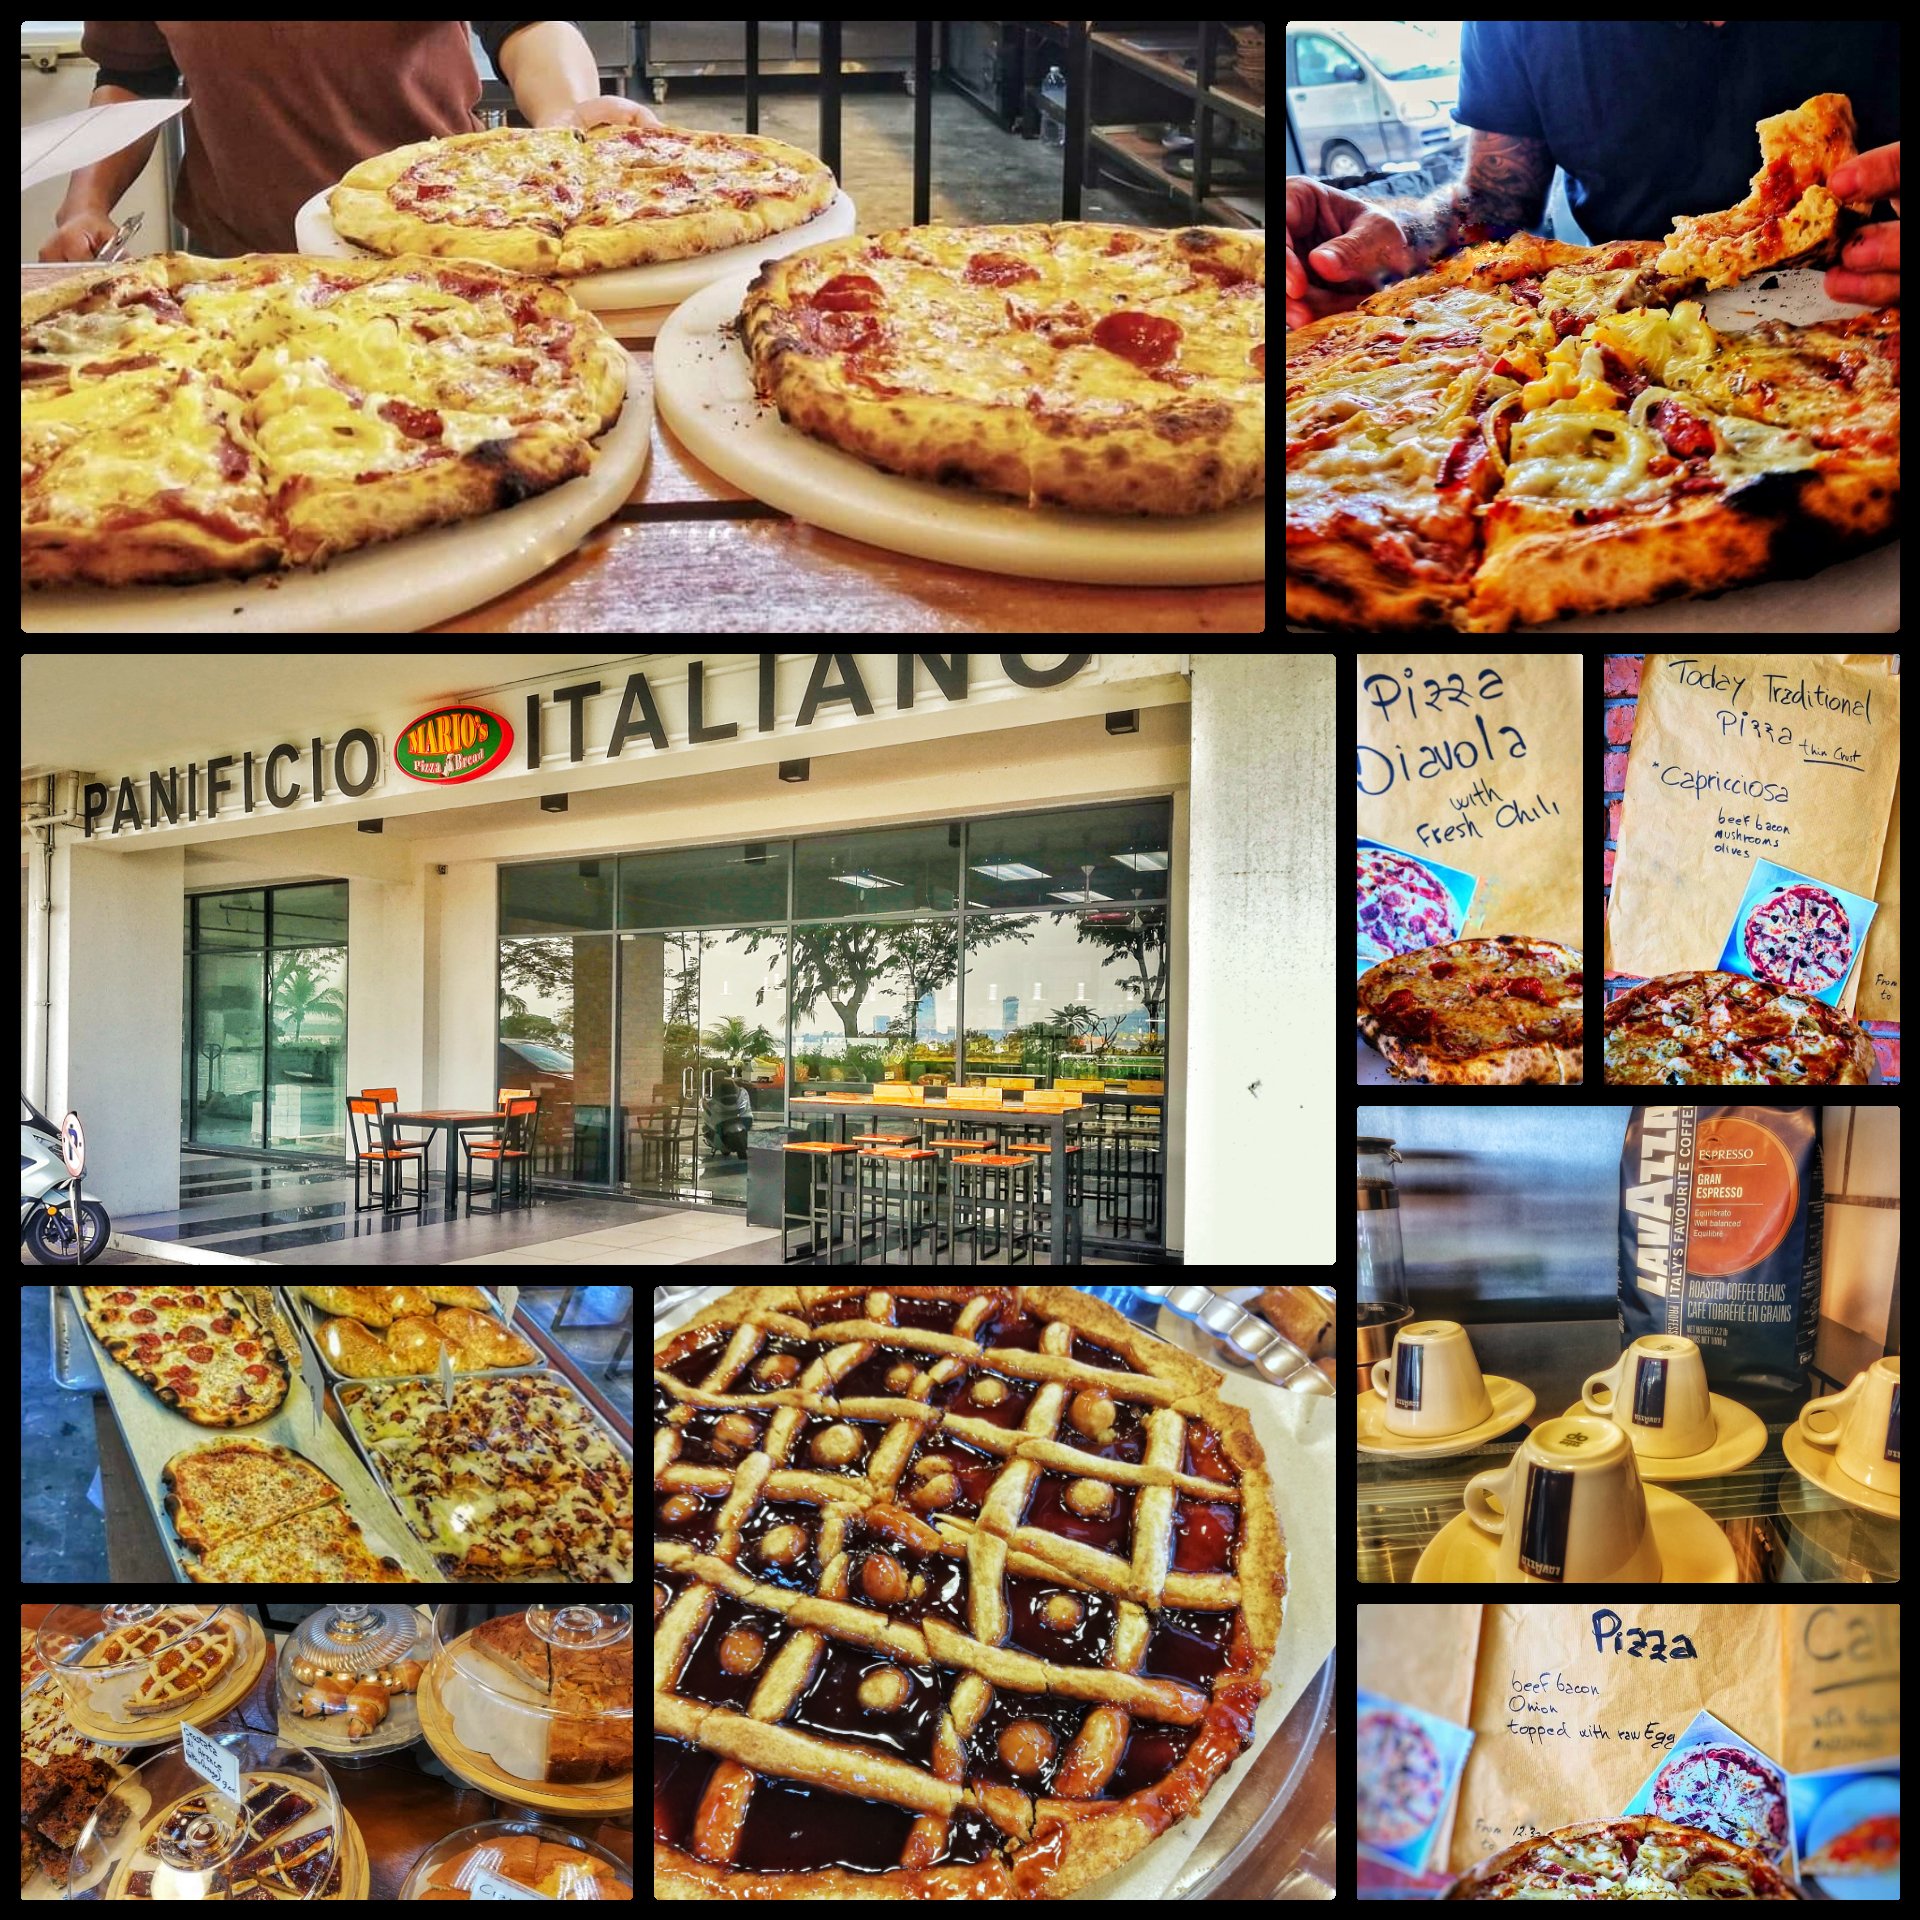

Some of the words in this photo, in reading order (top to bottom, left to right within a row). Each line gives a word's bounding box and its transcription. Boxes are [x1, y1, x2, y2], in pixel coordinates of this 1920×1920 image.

[1363, 667, 1504, 722] Pizza
[1668, 659, 1746, 706] Today
[1762, 674, 1872, 725] Traditional
[408, 713, 489, 755] MARIO's
[1716, 710, 1792, 745] Pizza
[414, 760, 441, 774] Pizza
[454, 748, 485, 770] Bread
[1357, 714, 1527, 795] Diavola
[85, 728, 377, 837] PANIFICIO
[1450, 778, 1503, 810] with
[1660, 765, 1789, 803] Capricciosa
[1416, 812, 1484, 847] Fresh
[1717, 807, 1750, 826] beef
[1755, 814, 1791, 835] bacon
[1714, 844, 1750, 858] olives
[1875, 973, 1898, 987] From
[1881, 989, 1892, 1001] to
[1680, 1105, 1695, 1157] COFFE
[1699, 1148, 1754, 1160] ESPRESSO
[1696, 1187, 1743, 1198] ESPRESSO
[1697, 1173, 1722, 1185] GRAN
[1626, 1105, 1679, 1298] LAVAZZA
[1673, 1162, 1690, 1243] FAVOURITE
[1669, 1248, 1684, 1298] ITALY'S
[1688, 1280, 1725, 1300] ROASTED
[1726, 1282, 1757, 1302] COFFEE
[1757, 1284, 1786, 1302] BEANS
[1687, 1299, 1707, 1320] CAFÉ
[1708, 1301, 1747, 1322] TORRÉFIÉ
[1747, 1305, 1759, 1323] EN
[1760, 1305, 1792, 1323] GRAINS
[1522, 1555, 1561, 1576] LAVAZZA
[1592, 1608, 1698, 1663] Pizza
[1512, 1670, 1550, 1694] beef
[1556, 1673, 1600, 1696] bacon
[1508, 1695, 1558, 1714] Onion
[1507, 1719, 1572, 1745] topped
[1579, 1725, 1611, 1740] with
[1618, 1730, 1640, 1741] raw
[1644, 1721, 1676, 1749] Egg
